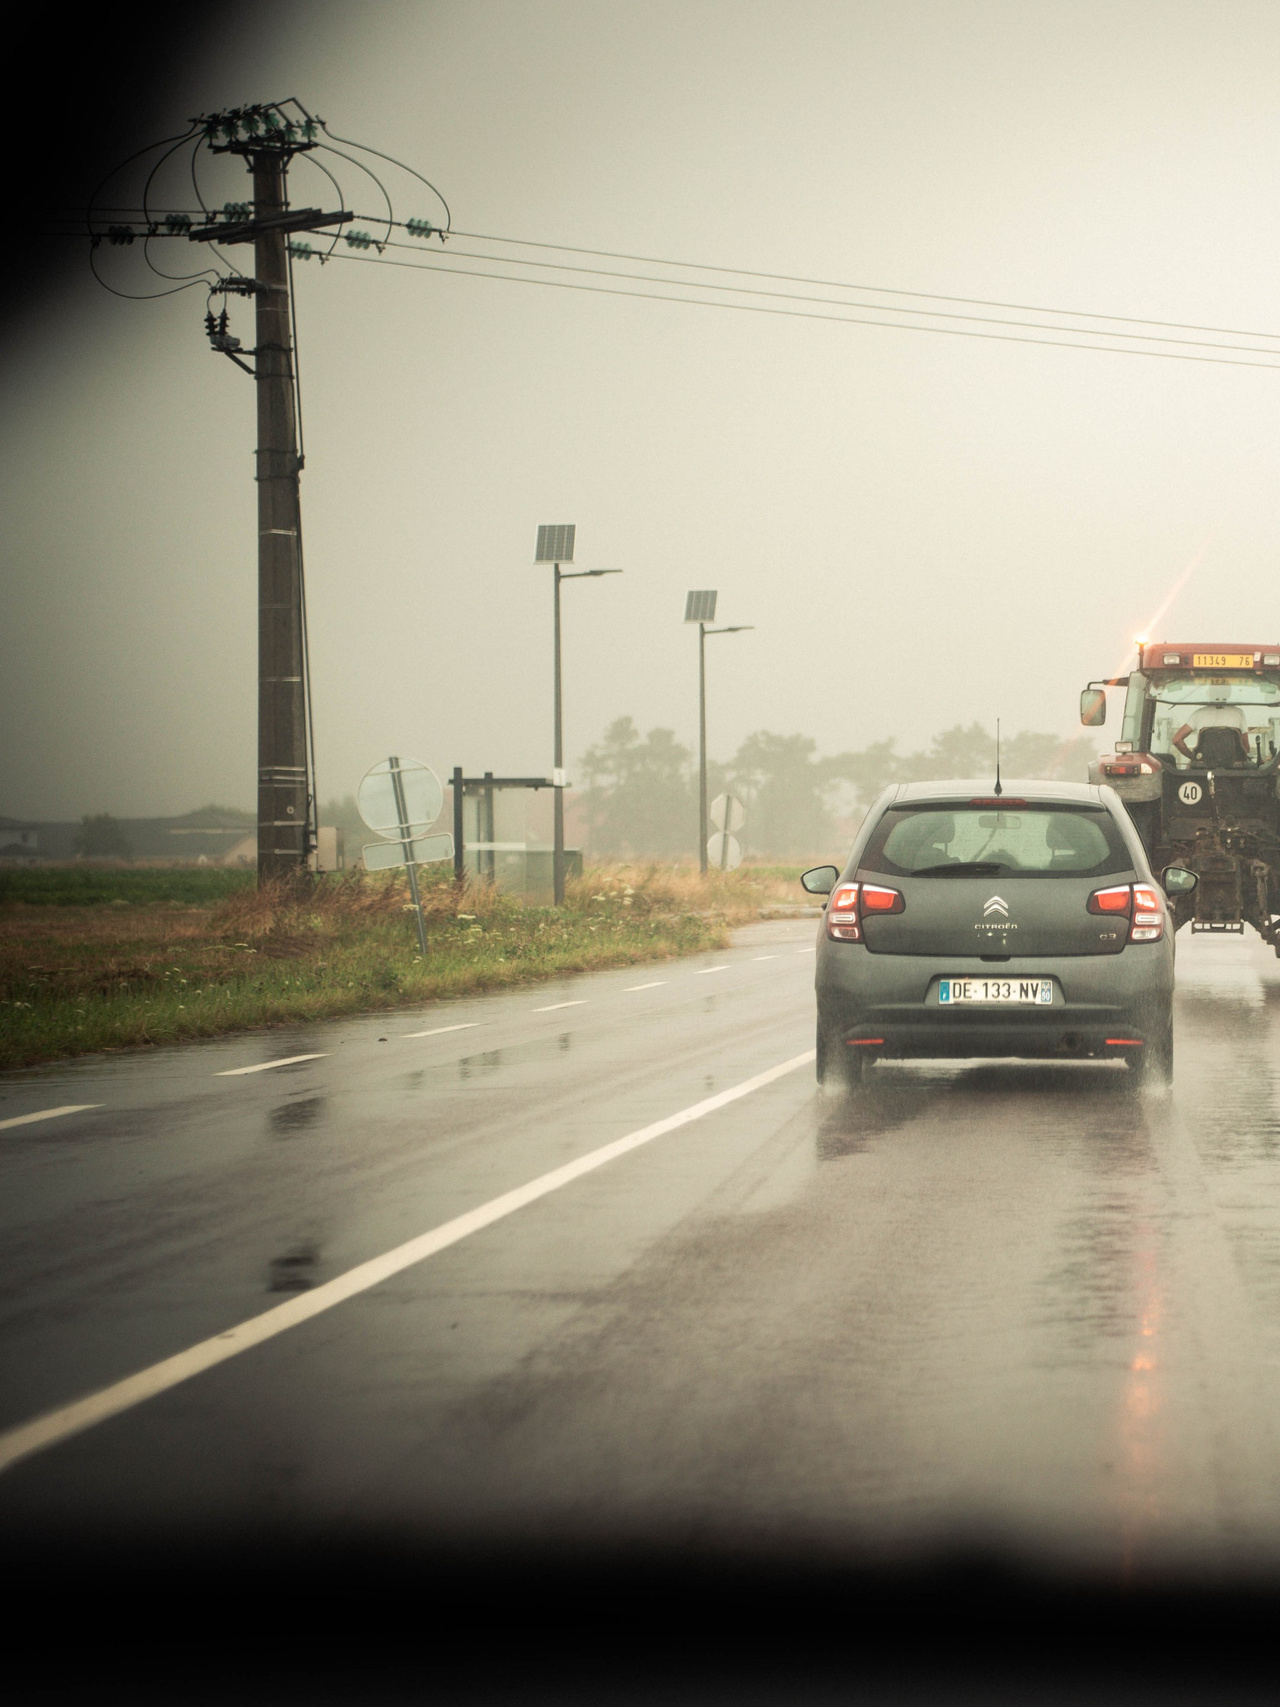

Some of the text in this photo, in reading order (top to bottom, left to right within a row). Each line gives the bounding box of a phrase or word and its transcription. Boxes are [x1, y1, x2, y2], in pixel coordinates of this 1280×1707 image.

[1197, 656, 1250, 666] 11349 76
[1183, 786, 1198, 800] 40
